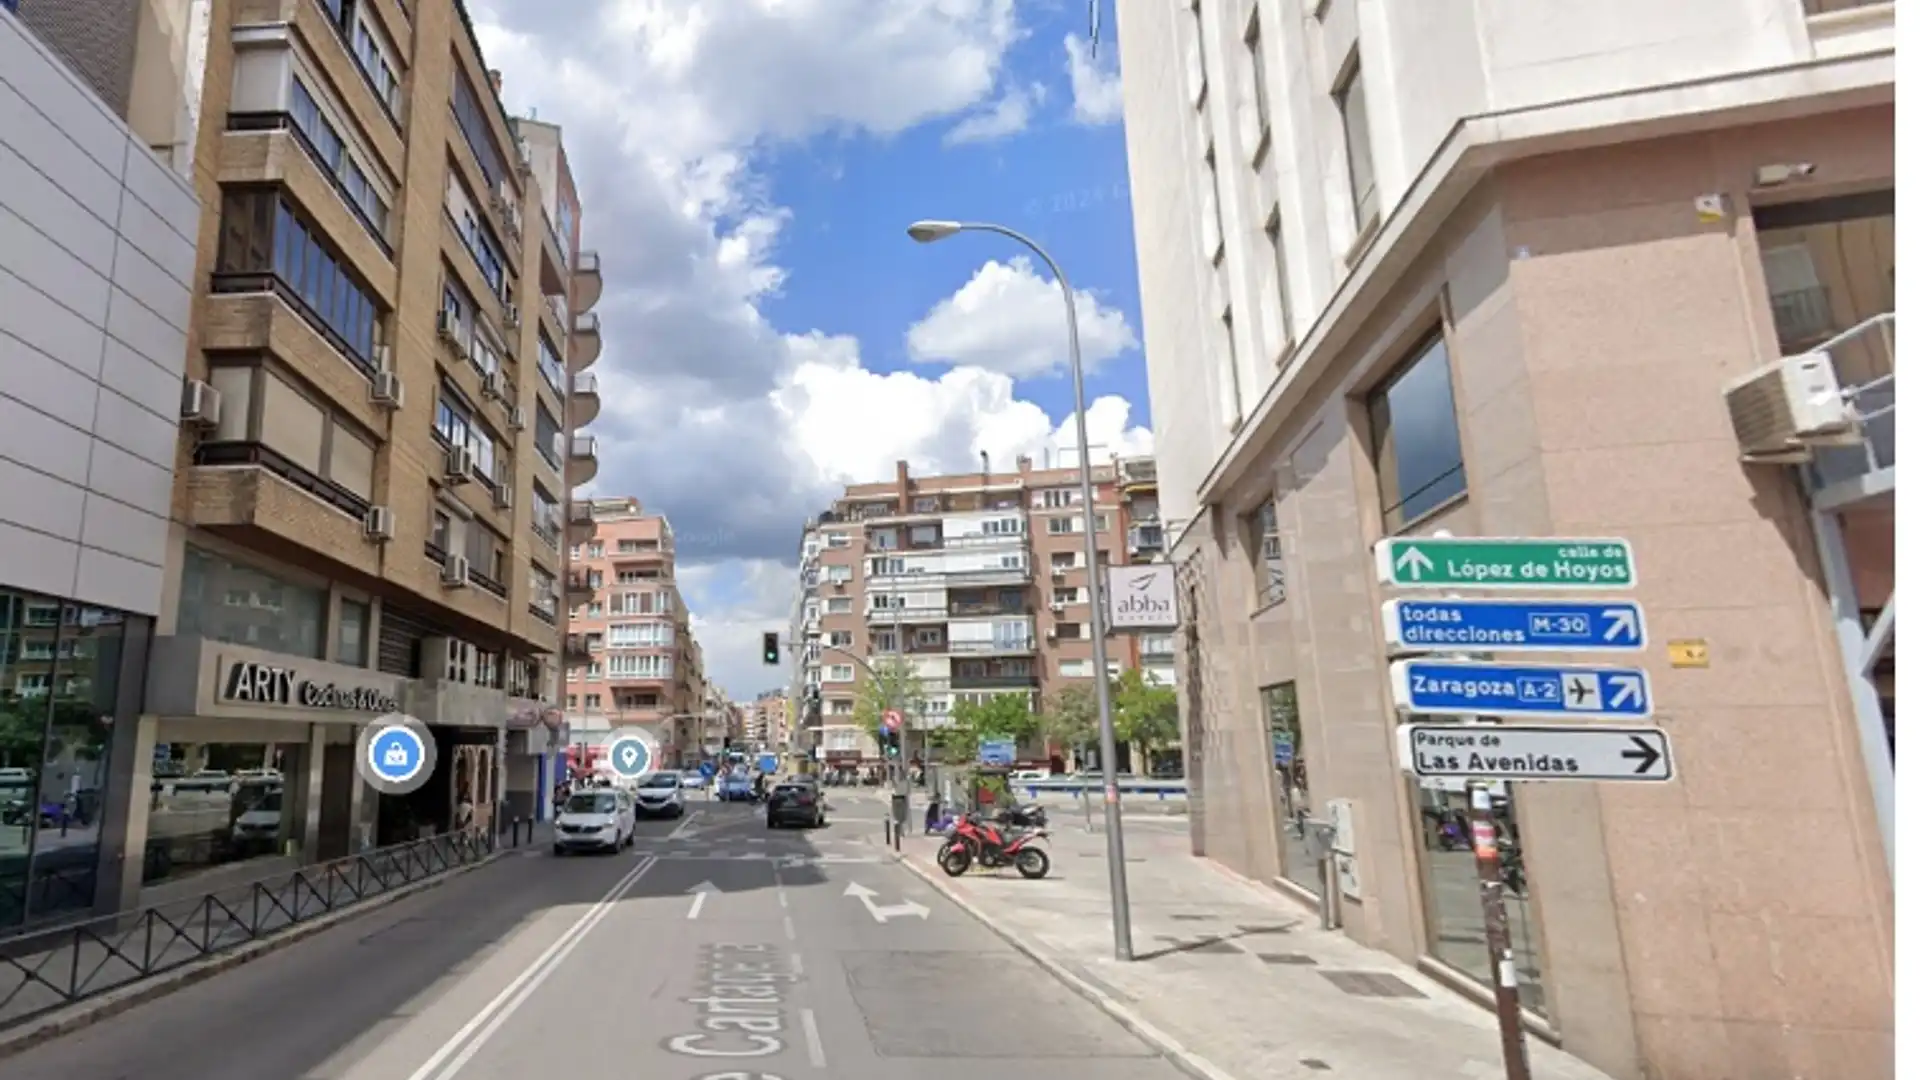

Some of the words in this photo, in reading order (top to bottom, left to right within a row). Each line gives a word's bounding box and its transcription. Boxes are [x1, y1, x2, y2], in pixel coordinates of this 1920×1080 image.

[1558, 545, 1600, 558] calle
[1603, 546, 1622, 558] de
[1447, 559, 1513, 581] López
[1520, 560, 1548, 578] de
[1554, 560, 1627, 582] Hoyos
[1117, 593, 1170, 613] abba
[1403, 605, 1463, 622] todas
[1404, 625, 1526, 643] direcciones
[1532, 616, 1588, 634] M-30
[234, 662, 297, 703] ARTY
[1412, 676, 1517, 699] Zaragoza
[1523, 682, 1558, 699] A-2
[1417, 732, 1476, 749] Parque
[1479, 733, 1501, 748] de
[1418, 752, 1460, 770] Las
[1467, 752, 1579, 773] Avenidas
